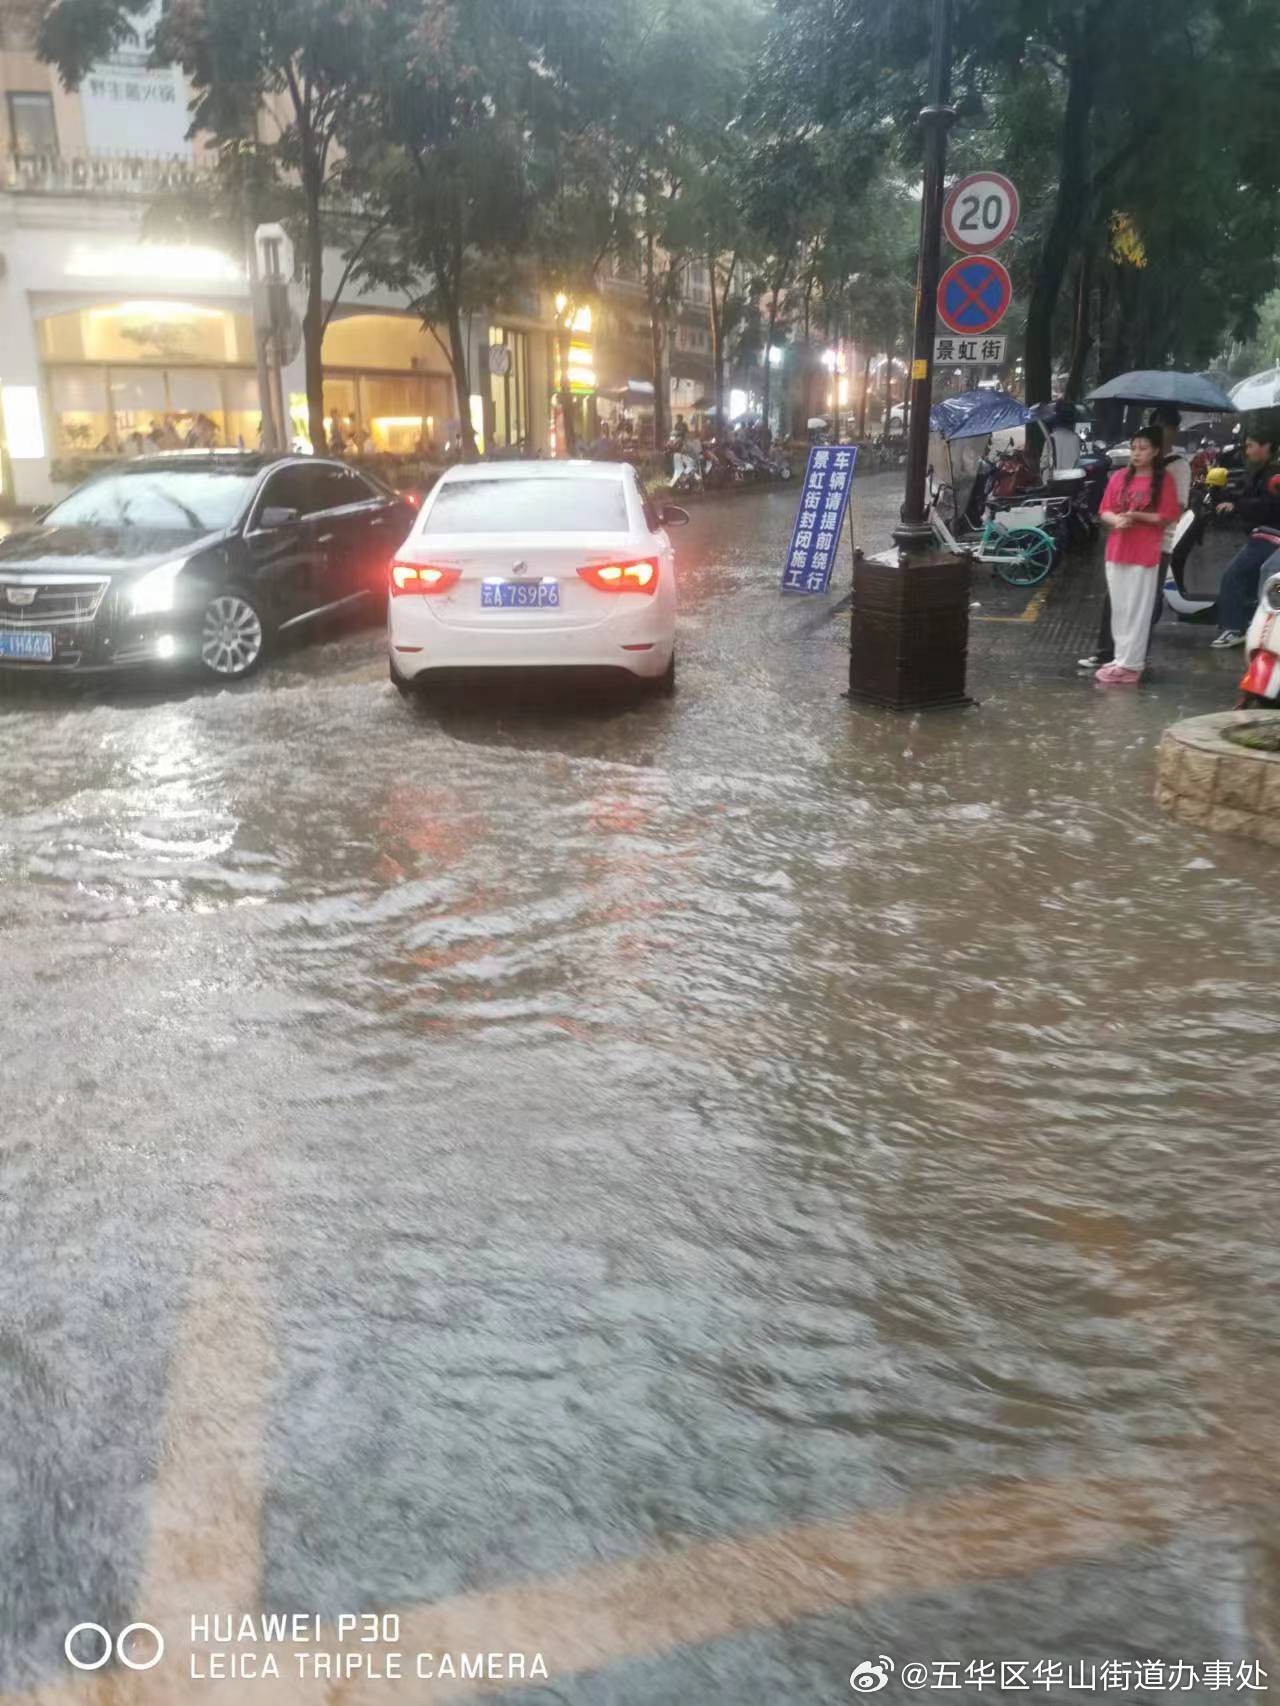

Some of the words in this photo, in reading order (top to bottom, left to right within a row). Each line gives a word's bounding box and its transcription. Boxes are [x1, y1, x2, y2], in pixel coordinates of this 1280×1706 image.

[959, 195, 1003, 230] 20
[936, 340, 1001, 361] 景虹街
[784, 450, 830, 588] 景虹街封闭施工
[806, 451, 851, 591] 车辆请提前绕行
